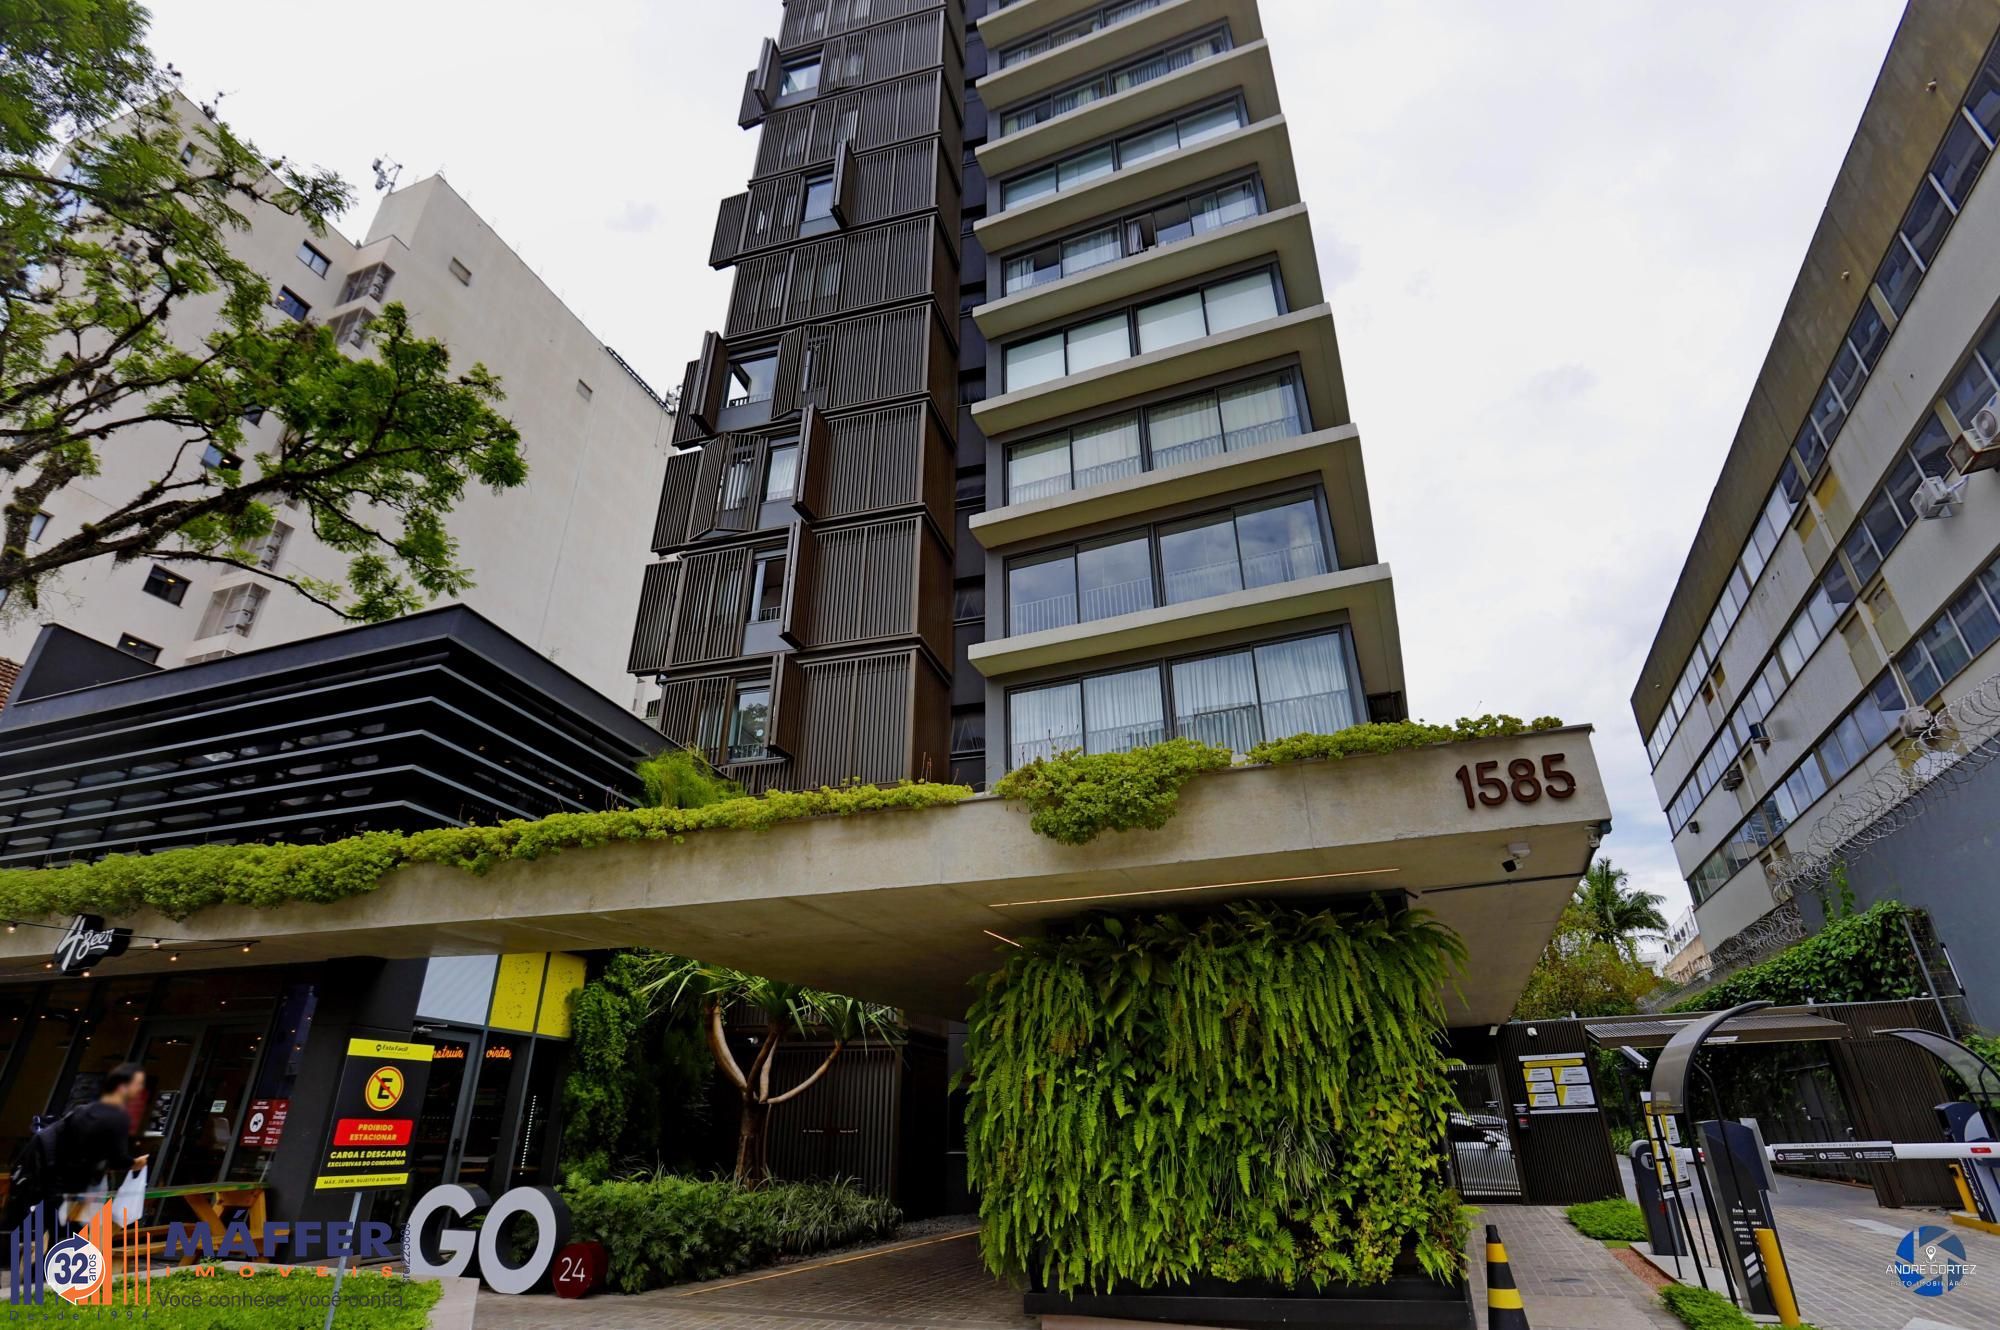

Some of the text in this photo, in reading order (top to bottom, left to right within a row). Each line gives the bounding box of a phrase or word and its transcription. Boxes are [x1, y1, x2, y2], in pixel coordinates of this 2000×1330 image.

[1455, 753, 1577, 809] 1585
[358, 1123, 394, 1131] PROIBIDO
[349, 1133, 397, 1141] ESTACIONAR
[330, 1151, 359, 1159] CARGA
[366, 1150, 407, 1158] DESCARGA
[405, 1184, 586, 1295] GO 24
